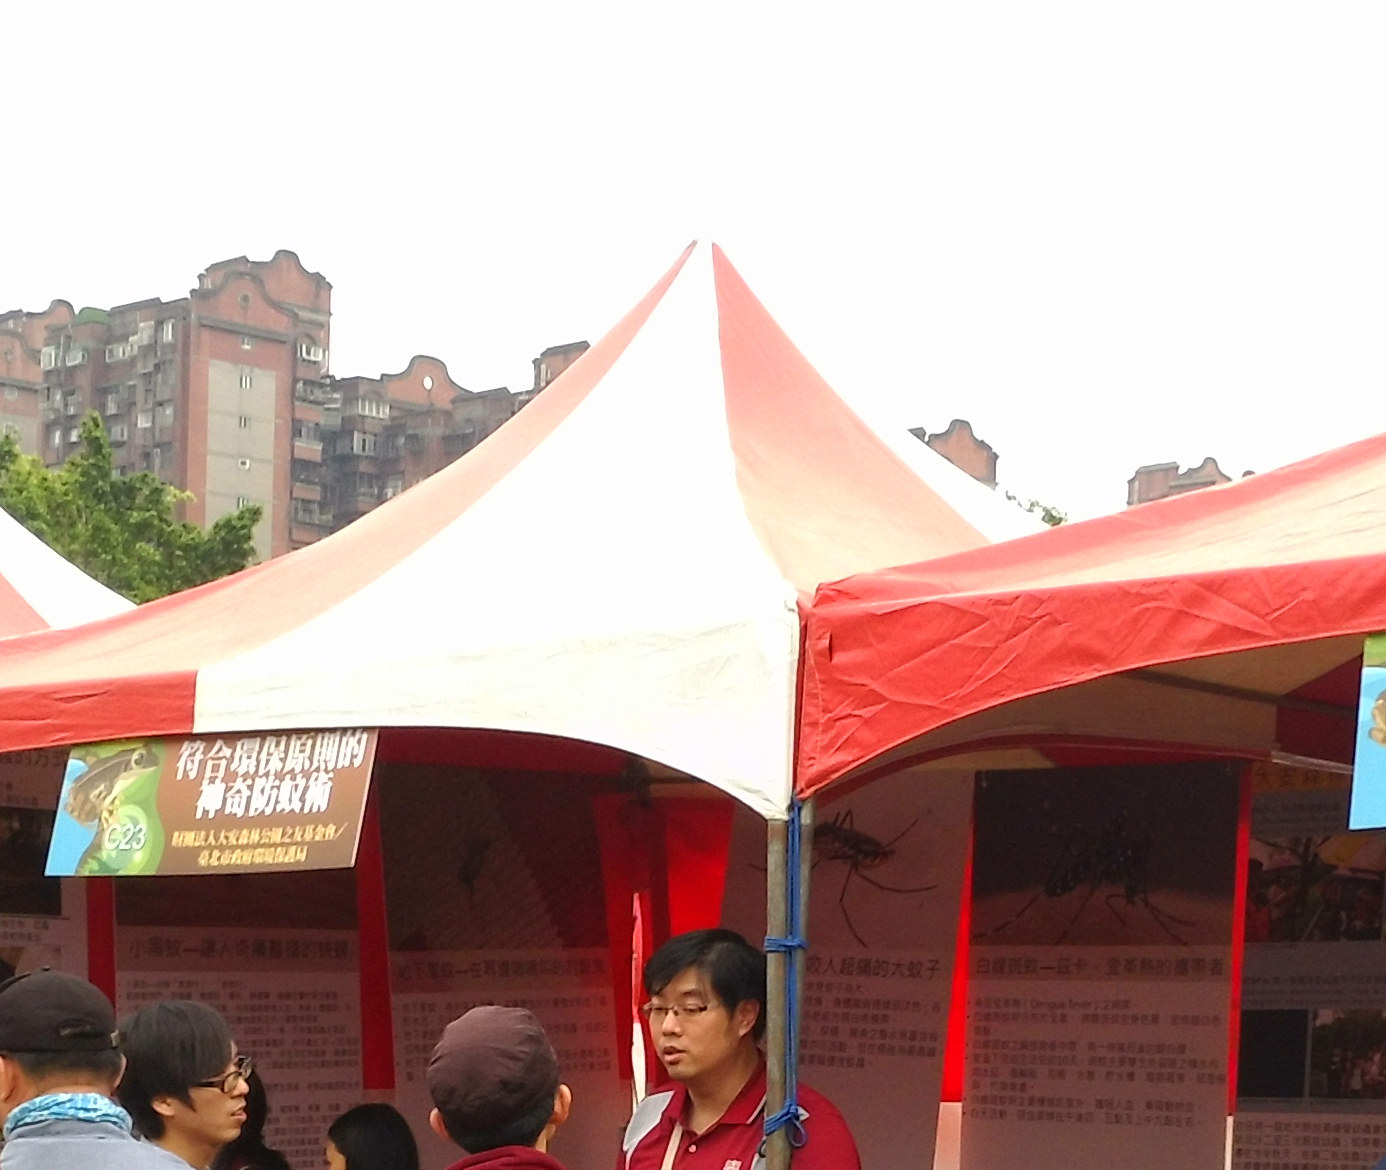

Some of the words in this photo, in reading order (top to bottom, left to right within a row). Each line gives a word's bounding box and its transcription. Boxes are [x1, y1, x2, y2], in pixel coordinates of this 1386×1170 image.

[176, 729, 368, 781] 符合環保原則的
[195, 772, 334, 820] 神奇防蚊術
[103, 823, 148, 851] C23
